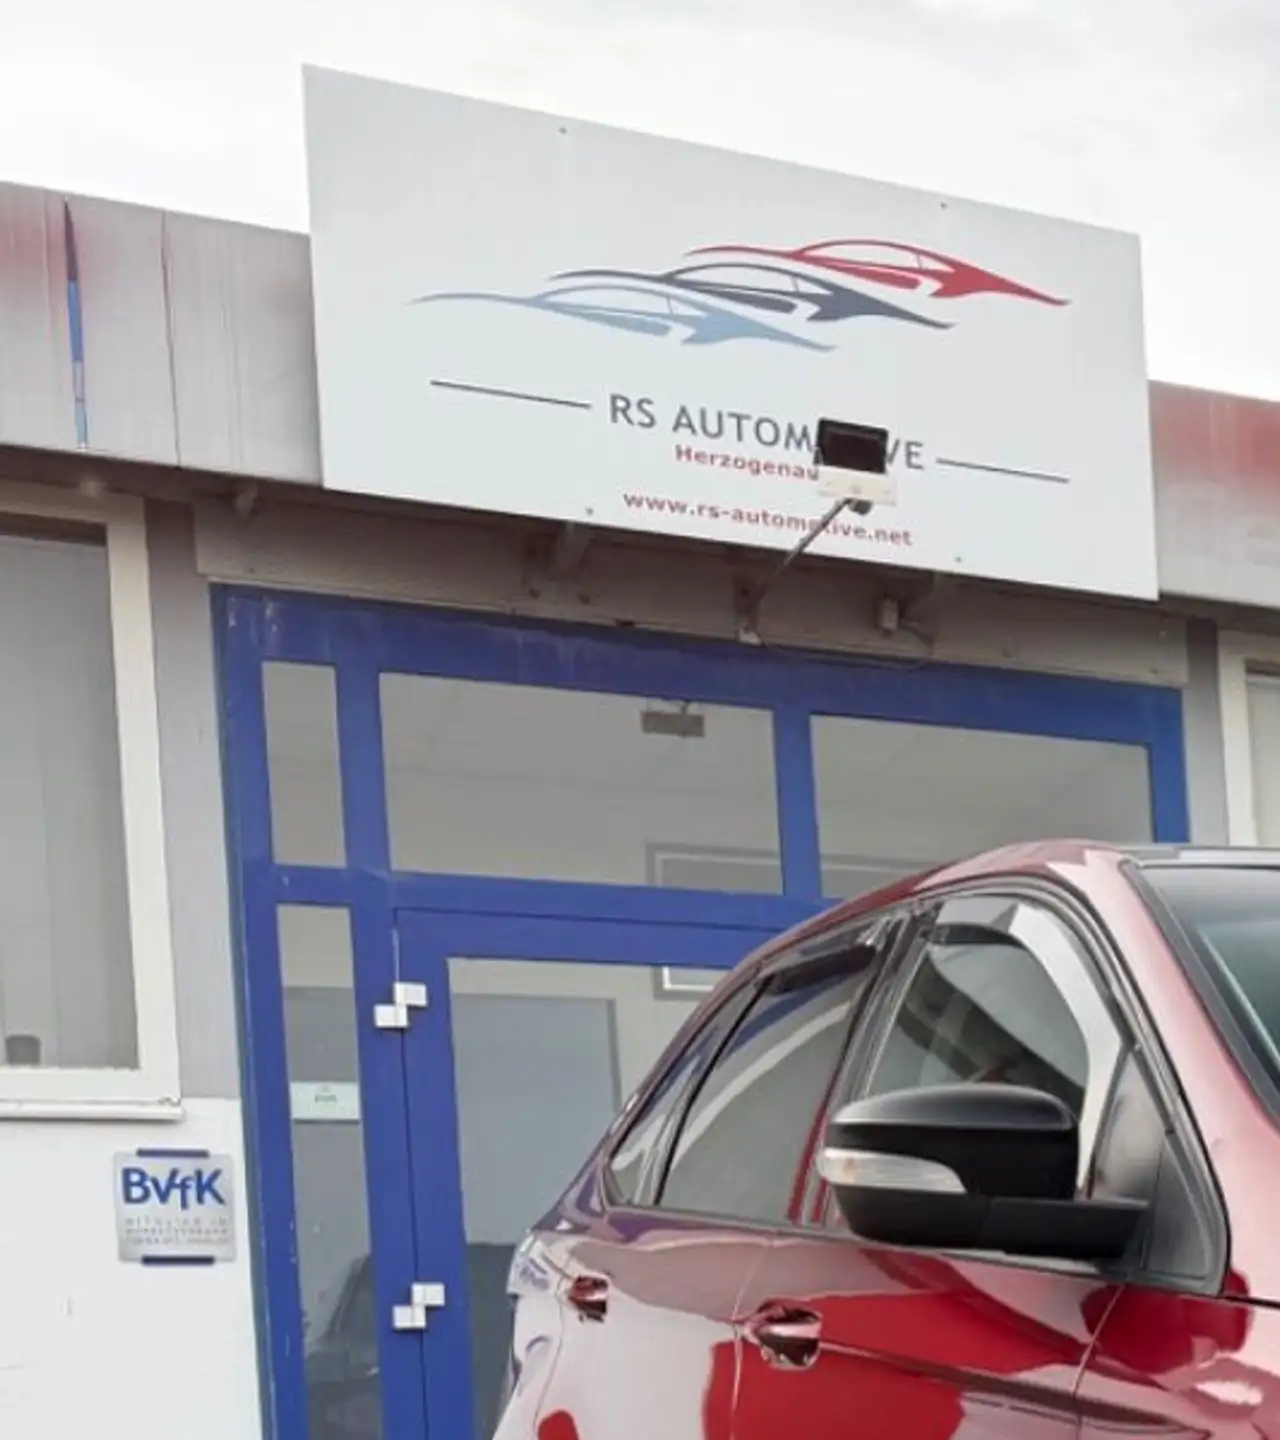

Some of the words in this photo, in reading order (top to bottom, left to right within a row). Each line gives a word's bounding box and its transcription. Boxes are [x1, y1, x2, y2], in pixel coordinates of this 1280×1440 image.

[609, 392, 656, 430] RS
[671, 404, 925, 470] AUTOMVE
[674, 444, 820, 481] Herzogenau
